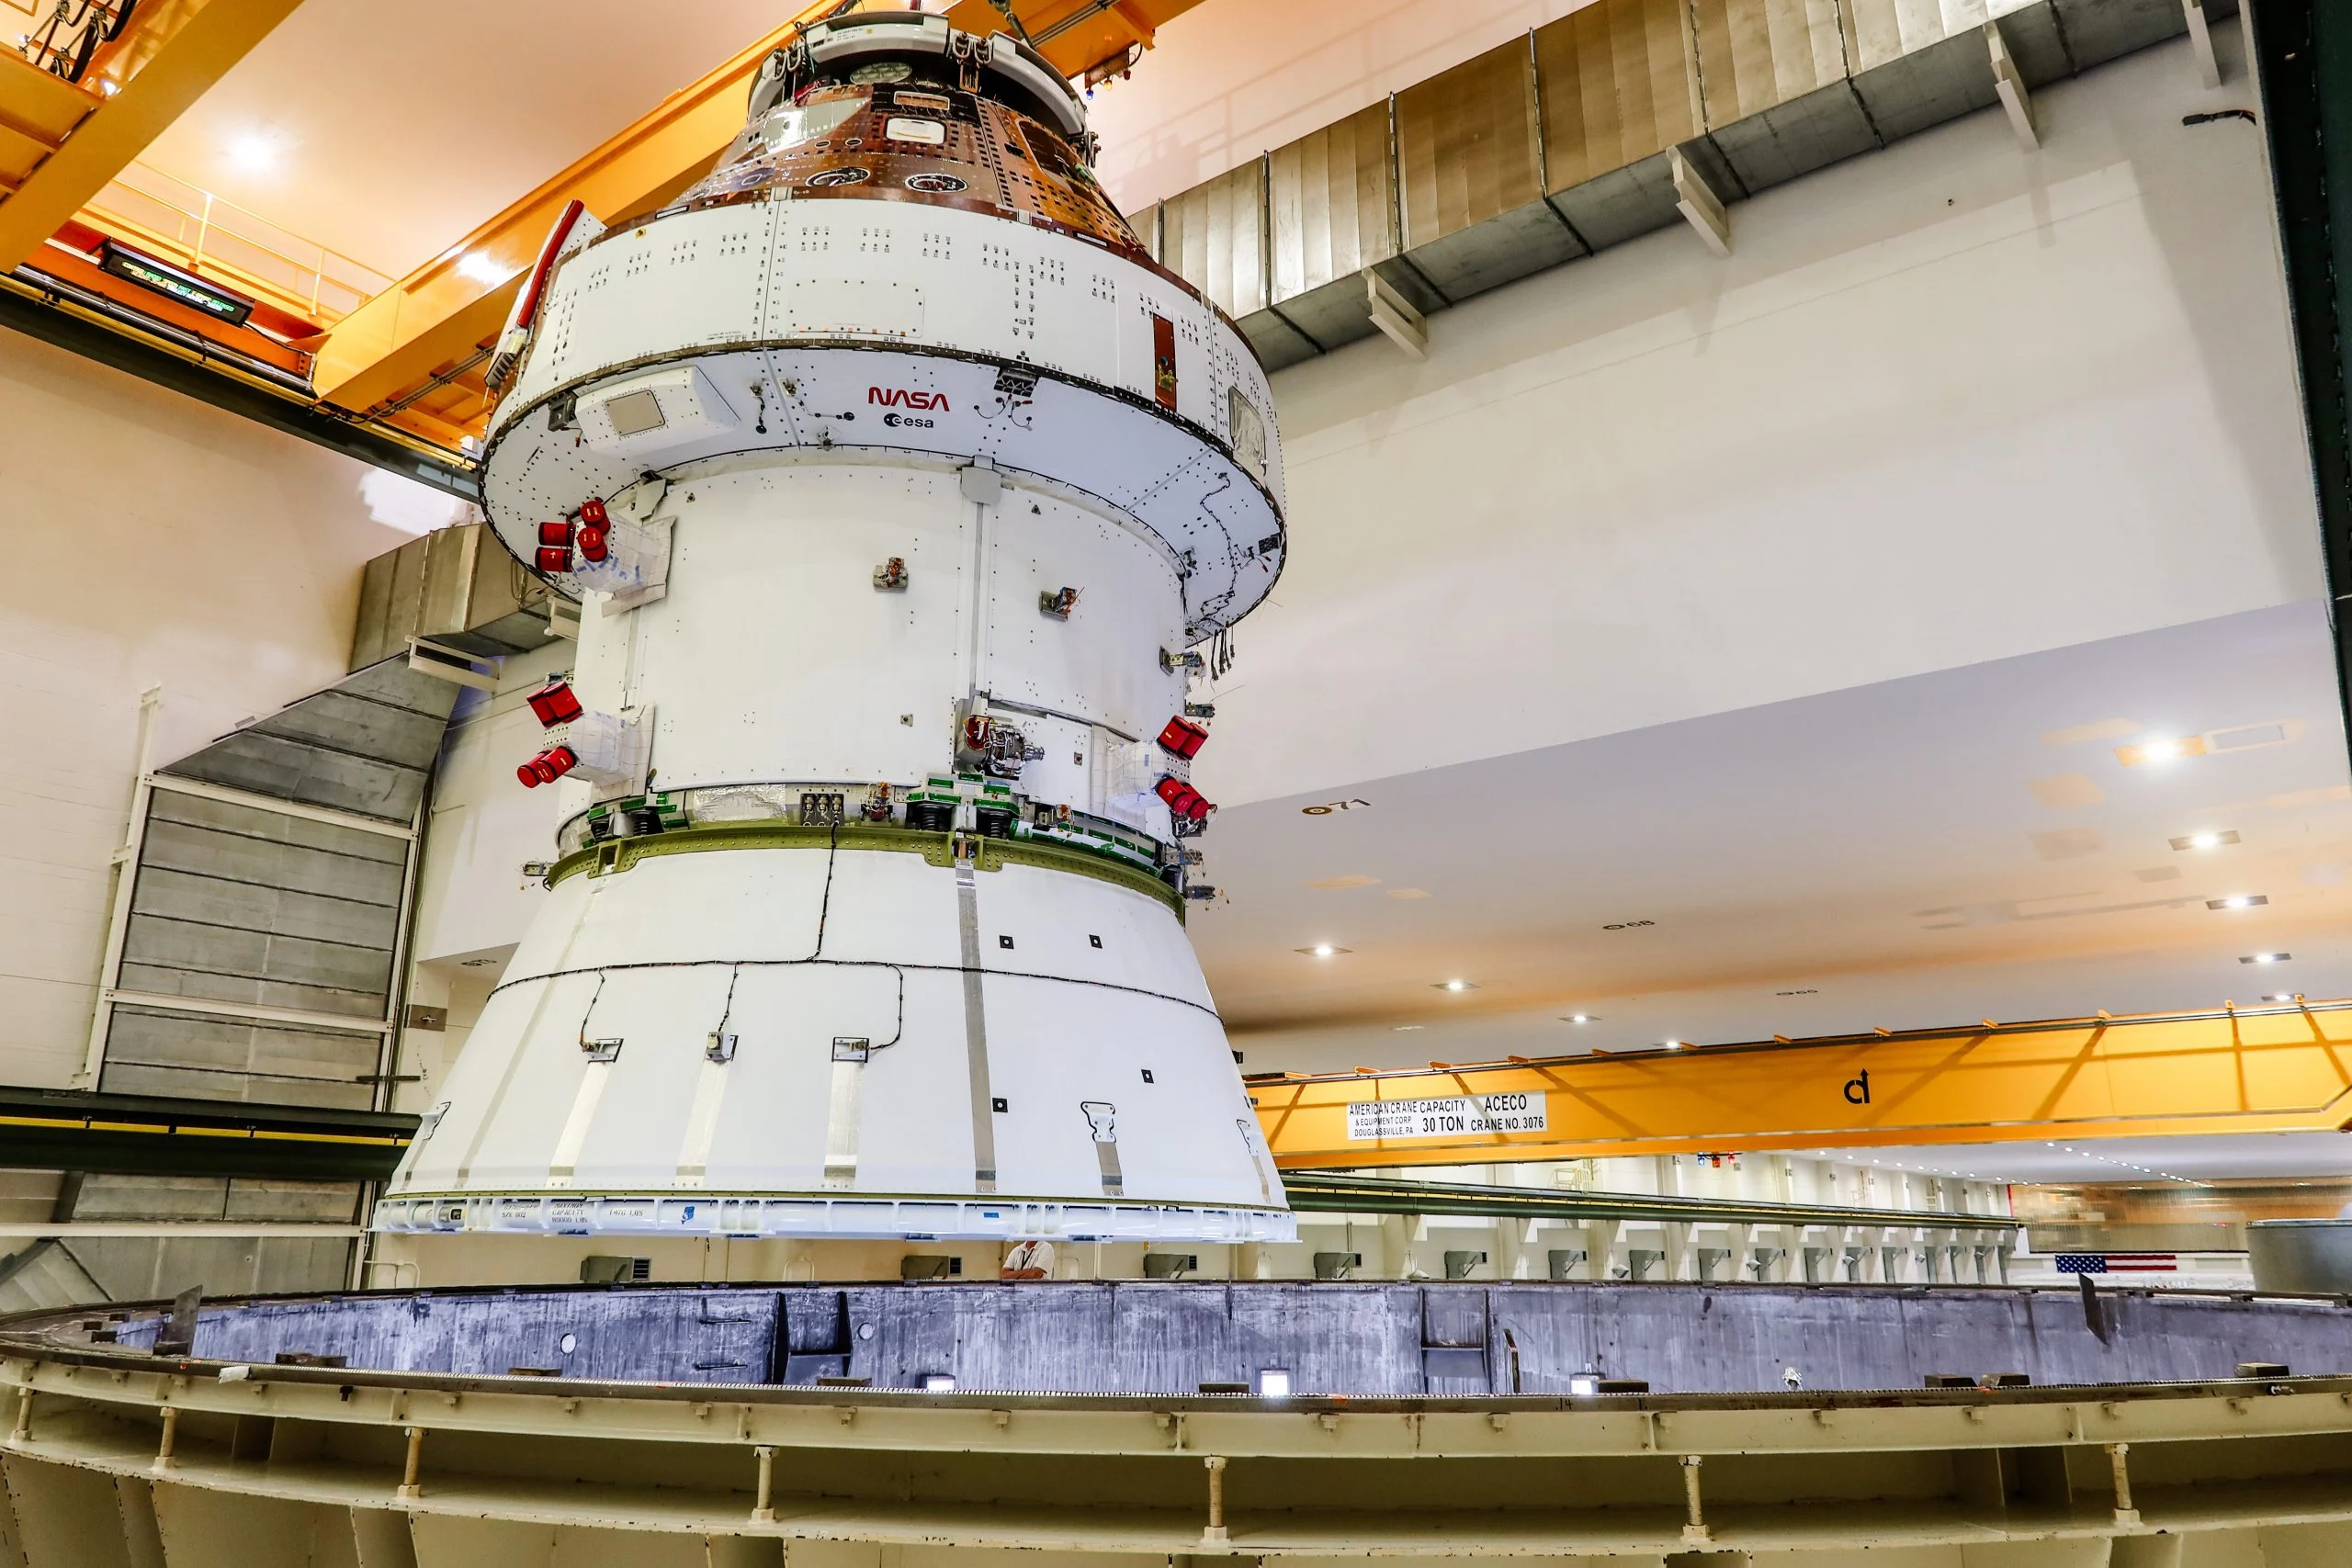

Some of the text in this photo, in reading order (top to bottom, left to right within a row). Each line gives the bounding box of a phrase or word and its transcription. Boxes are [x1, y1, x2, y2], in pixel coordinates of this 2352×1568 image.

[868, 387, 950, 412] NASA
[1349, 1101, 1418, 1116] AMERICAN CRANE
[1419, 1100, 1465, 1113] CAPACITY
[1484, 1094, 1527, 1112] ACECO
[1361, 1117, 1394, 1126] EQUIPMENT
[1422, 1116, 1464, 1133] 30 TON
[1470, 1116, 1544, 1132] CRANE NO. 3076
[1405, 1126, 1414, 1134] PA
